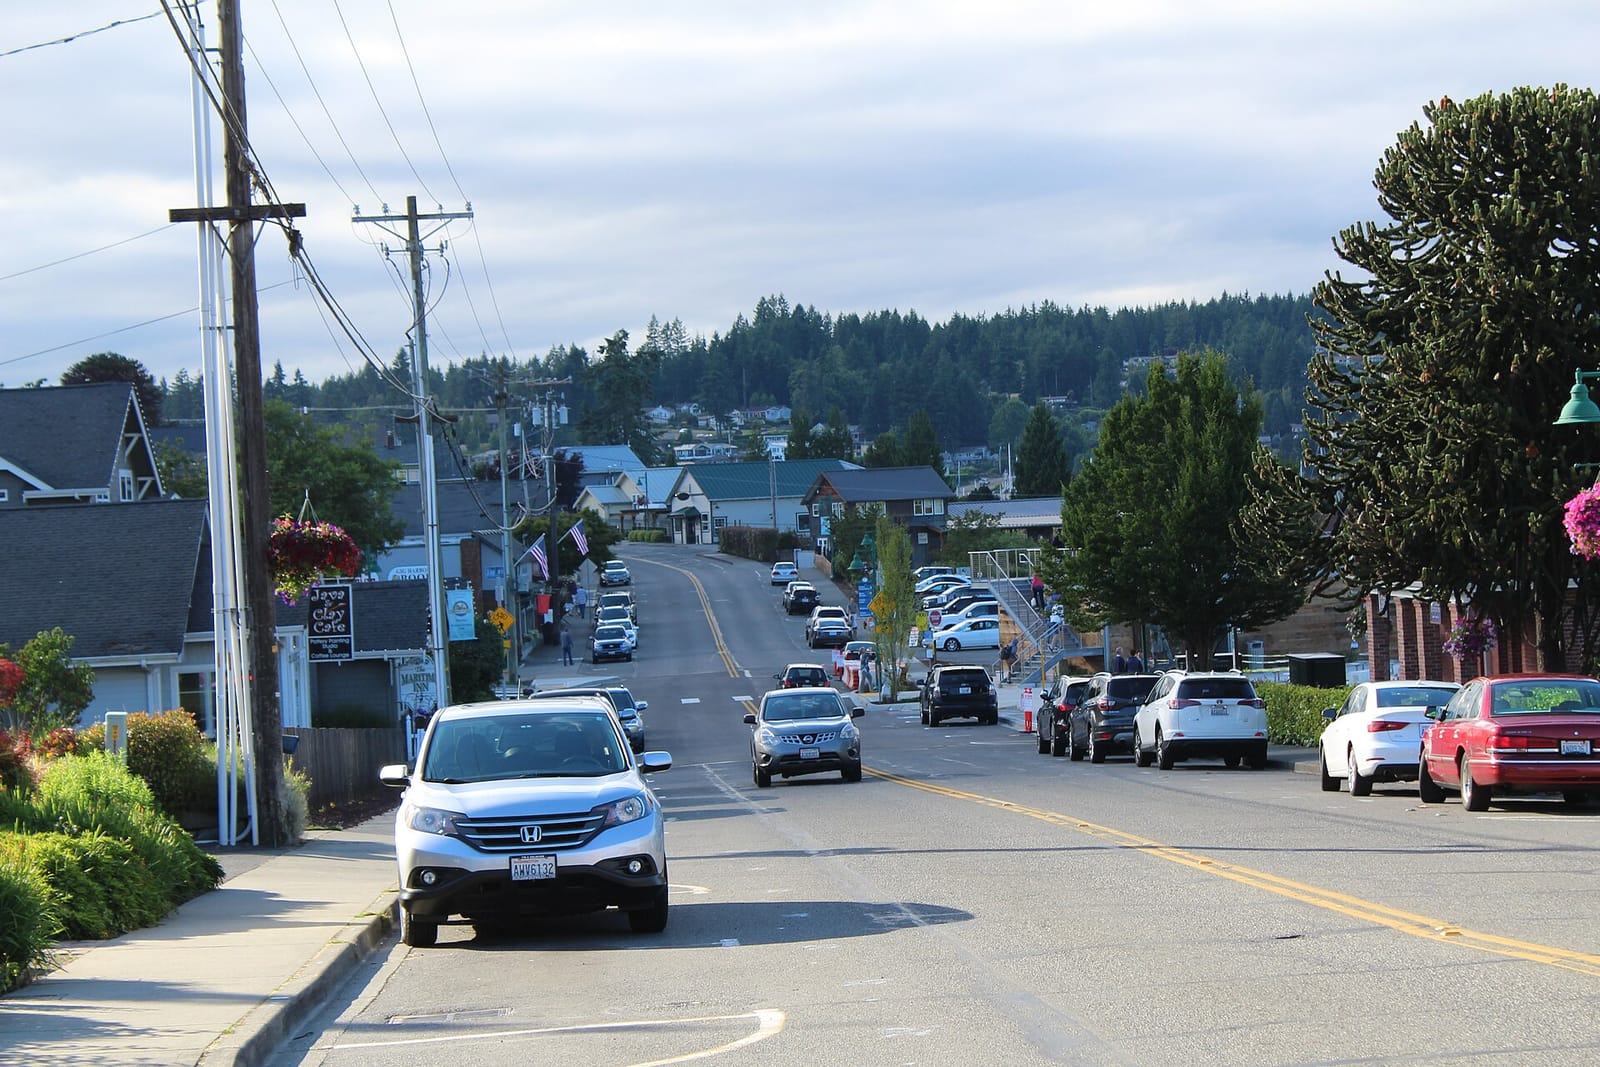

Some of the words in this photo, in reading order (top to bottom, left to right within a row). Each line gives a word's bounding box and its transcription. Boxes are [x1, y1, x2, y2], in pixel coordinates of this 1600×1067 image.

[311, 589, 345, 602] Java
[312, 607, 345, 621] Clay
[313, 620, 346, 633] Cafe
